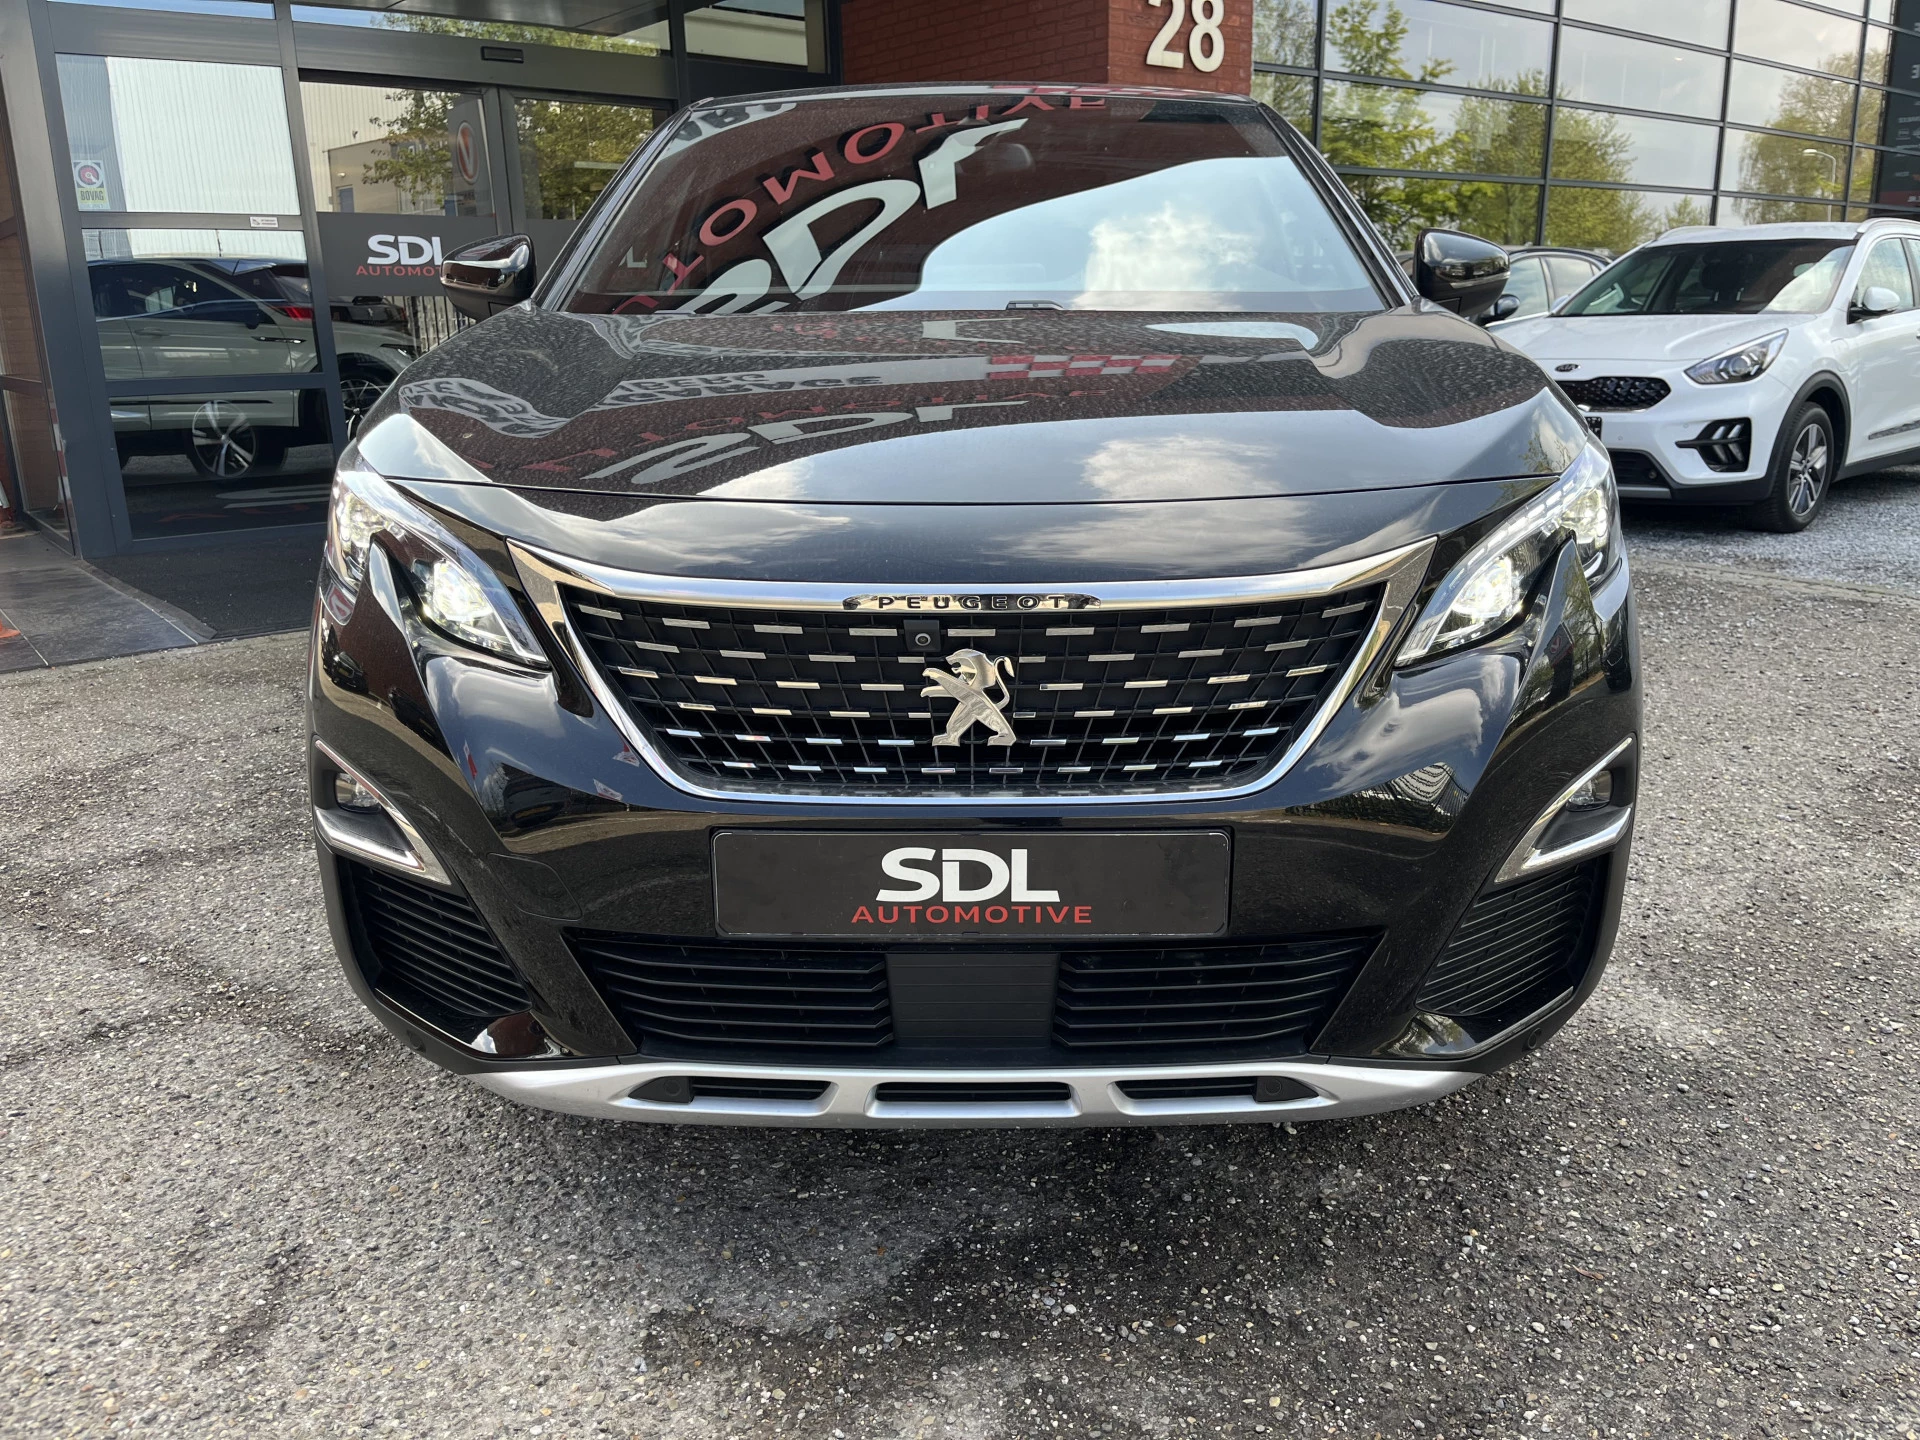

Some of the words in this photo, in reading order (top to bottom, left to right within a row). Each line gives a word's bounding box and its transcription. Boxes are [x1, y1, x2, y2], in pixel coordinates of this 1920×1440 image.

[1146, 0, 1225, 73] 28
[80, 190, 105, 201] BOVAG
[878, 595, 1065, 610] PEUGEOT
[875, 847, 1060, 902] SDL
[851, 905, 1092, 923] AUTOMOTIVE
